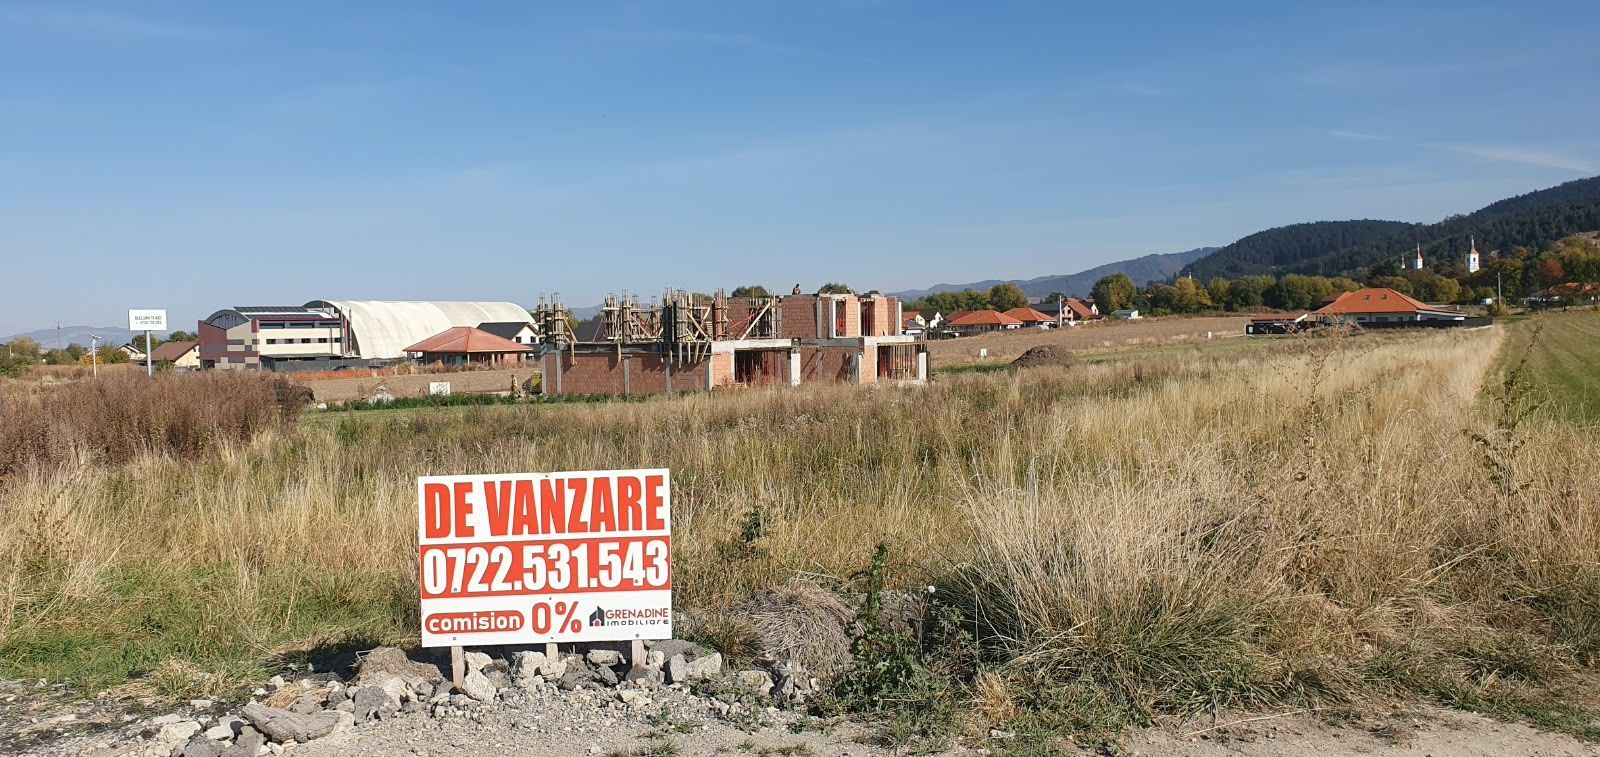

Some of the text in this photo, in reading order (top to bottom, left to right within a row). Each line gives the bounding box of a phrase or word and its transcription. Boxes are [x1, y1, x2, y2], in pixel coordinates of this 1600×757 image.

[424, 475, 665, 538] DE VANZARE
[423, 540, 668, 595] 0722.531.543
[429, 602, 582, 635] comision 0%
[605, 607, 669, 619] GRENADINE
